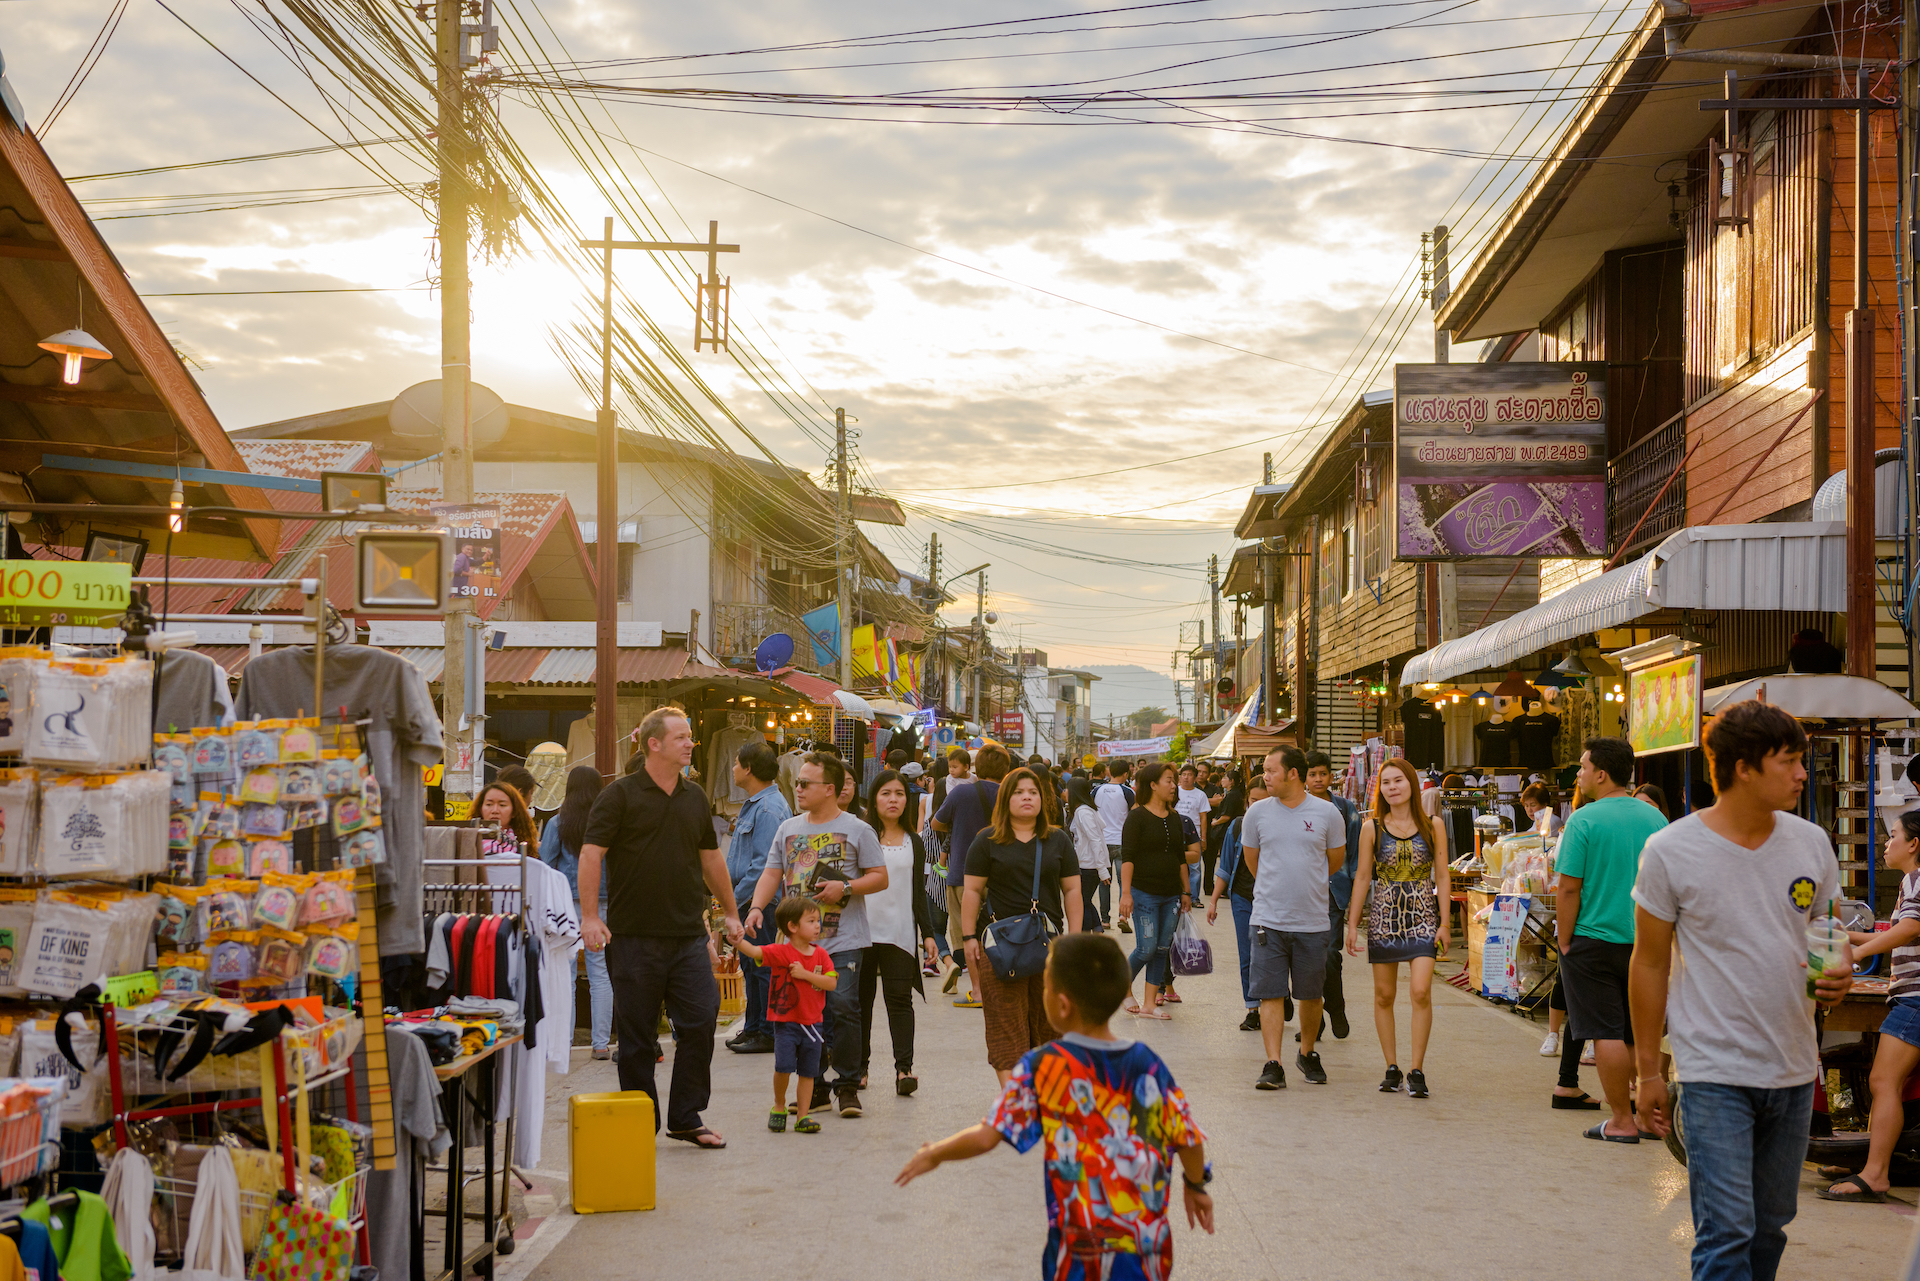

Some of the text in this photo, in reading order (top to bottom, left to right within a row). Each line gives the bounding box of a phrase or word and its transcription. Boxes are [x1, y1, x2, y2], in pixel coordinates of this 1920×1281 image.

[1404, 371, 1603, 433] แสนสุข สะดวกซื้อ
[1418, 440, 1588, 462] เฮือนยายสาย พ.ศ.2489
[448, 508, 497, 521] อร่อยจังเลย
[73, 583, 124, 602] บาท
[460, 586, 480, 596] 30
[49, 612, 68, 624] 20
[73, 614, 99, 626] บาท
[813, 833, 830, 849] 75
[40, 935, 90, 957] OF KING
